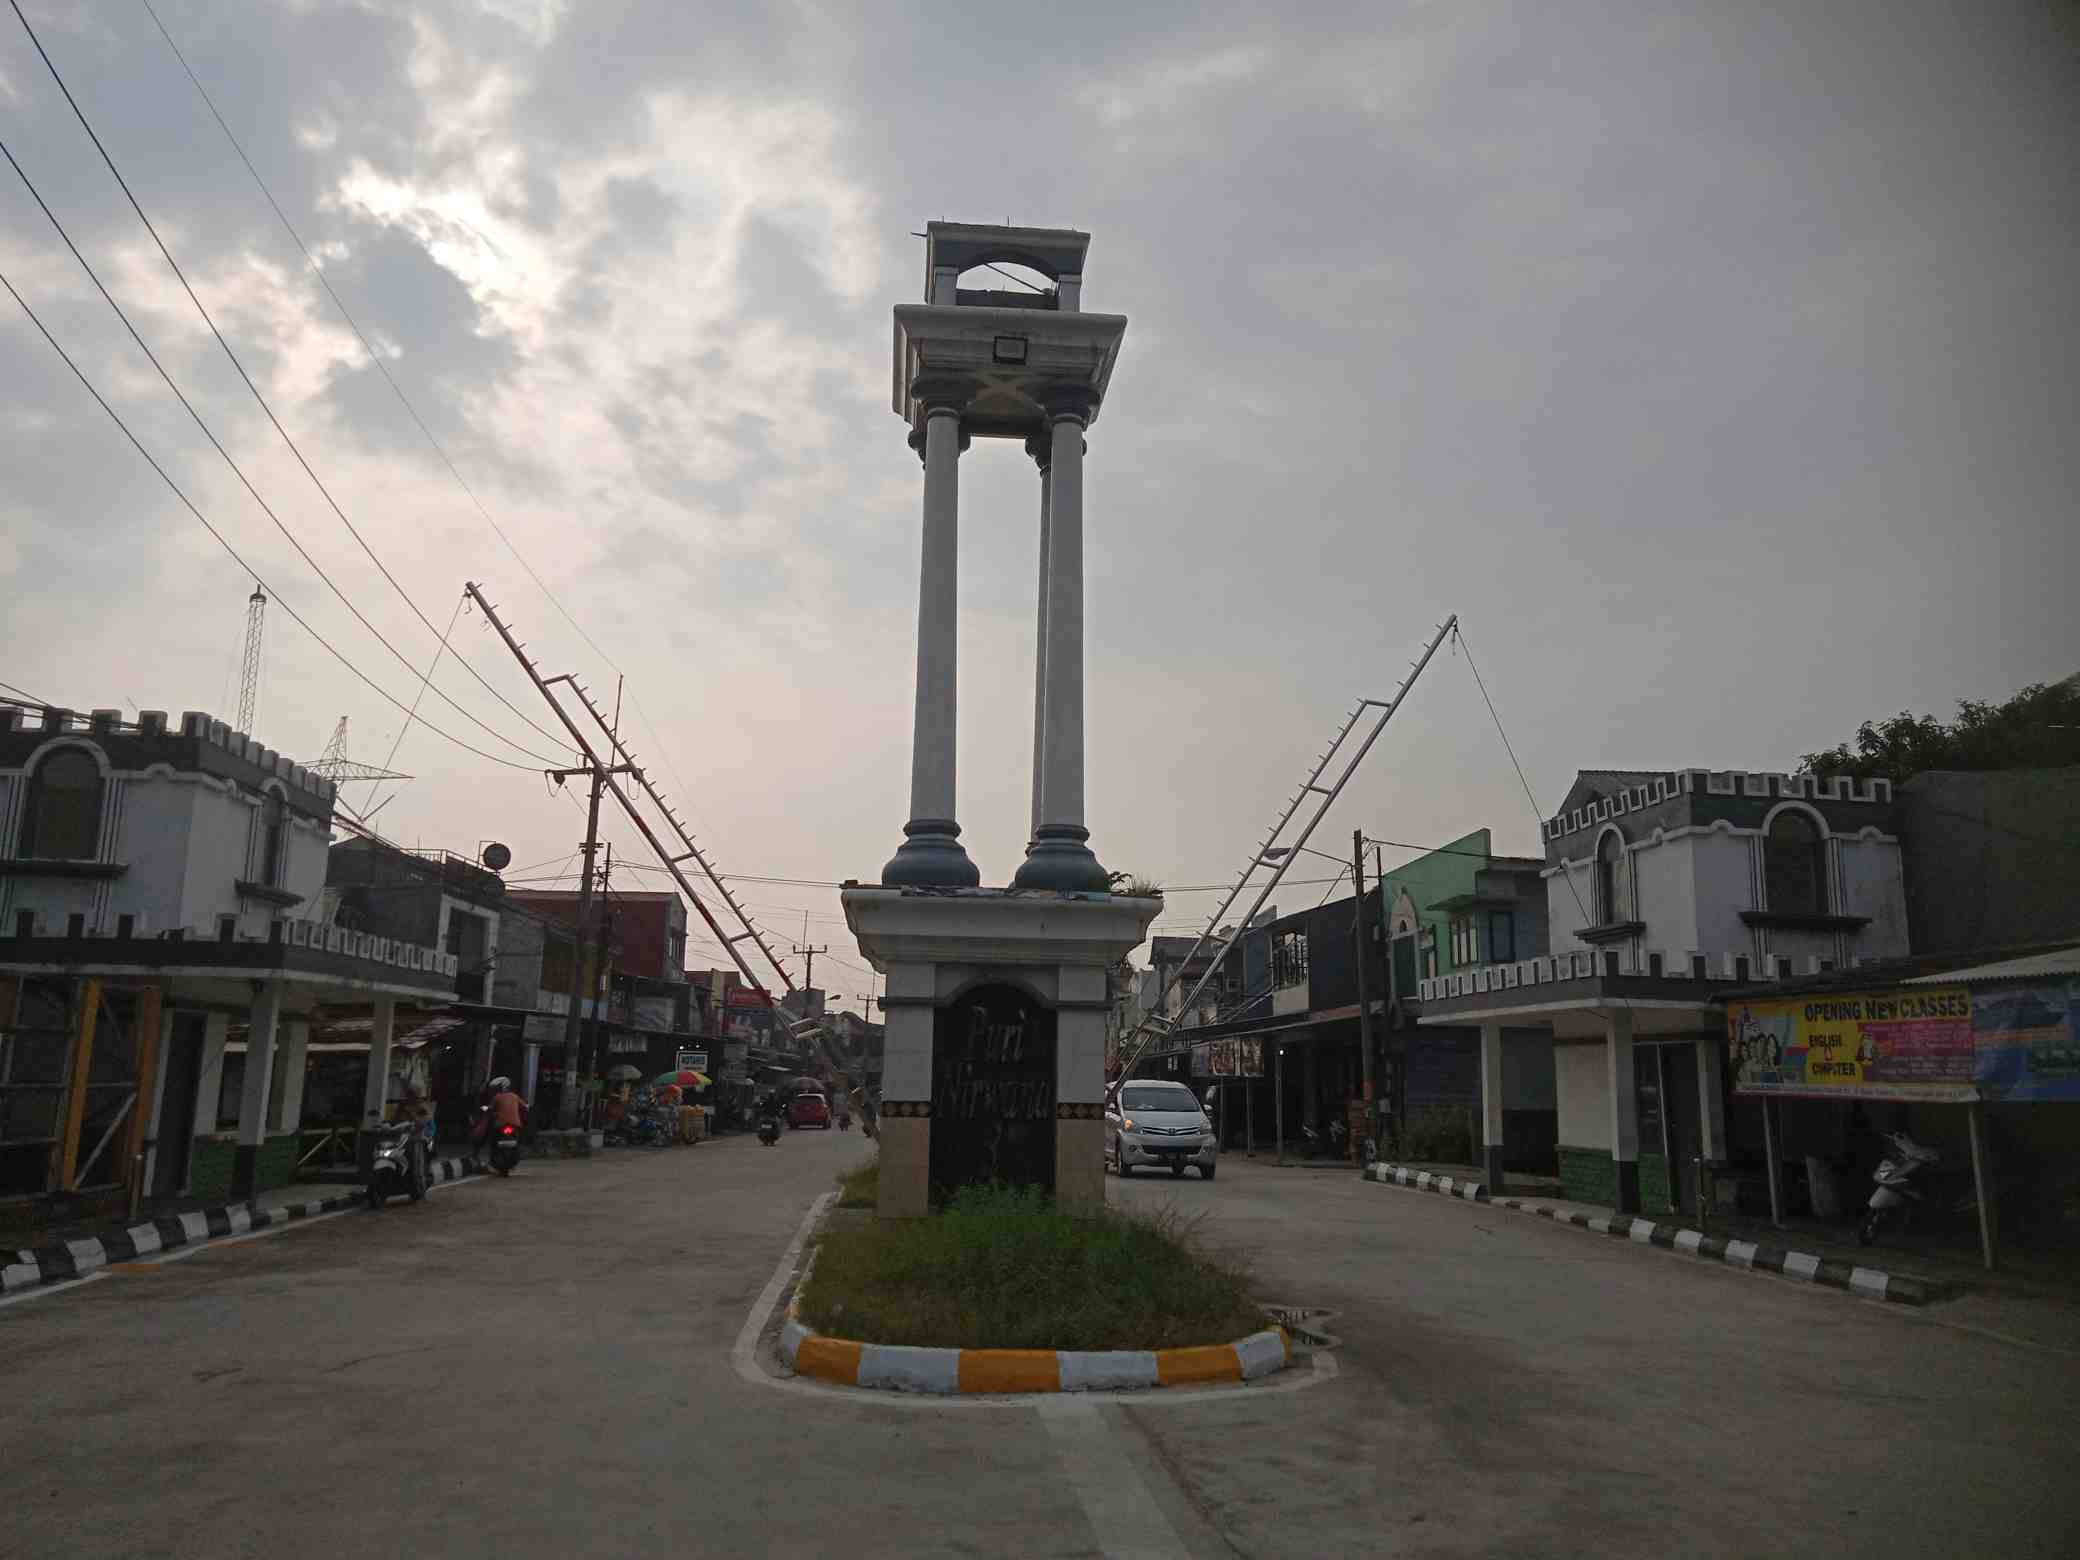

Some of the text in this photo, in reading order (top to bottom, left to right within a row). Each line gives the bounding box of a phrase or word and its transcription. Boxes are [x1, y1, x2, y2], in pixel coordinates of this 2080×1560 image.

[1804, 996, 1969, 1022] OPENING NEW CLASSES
